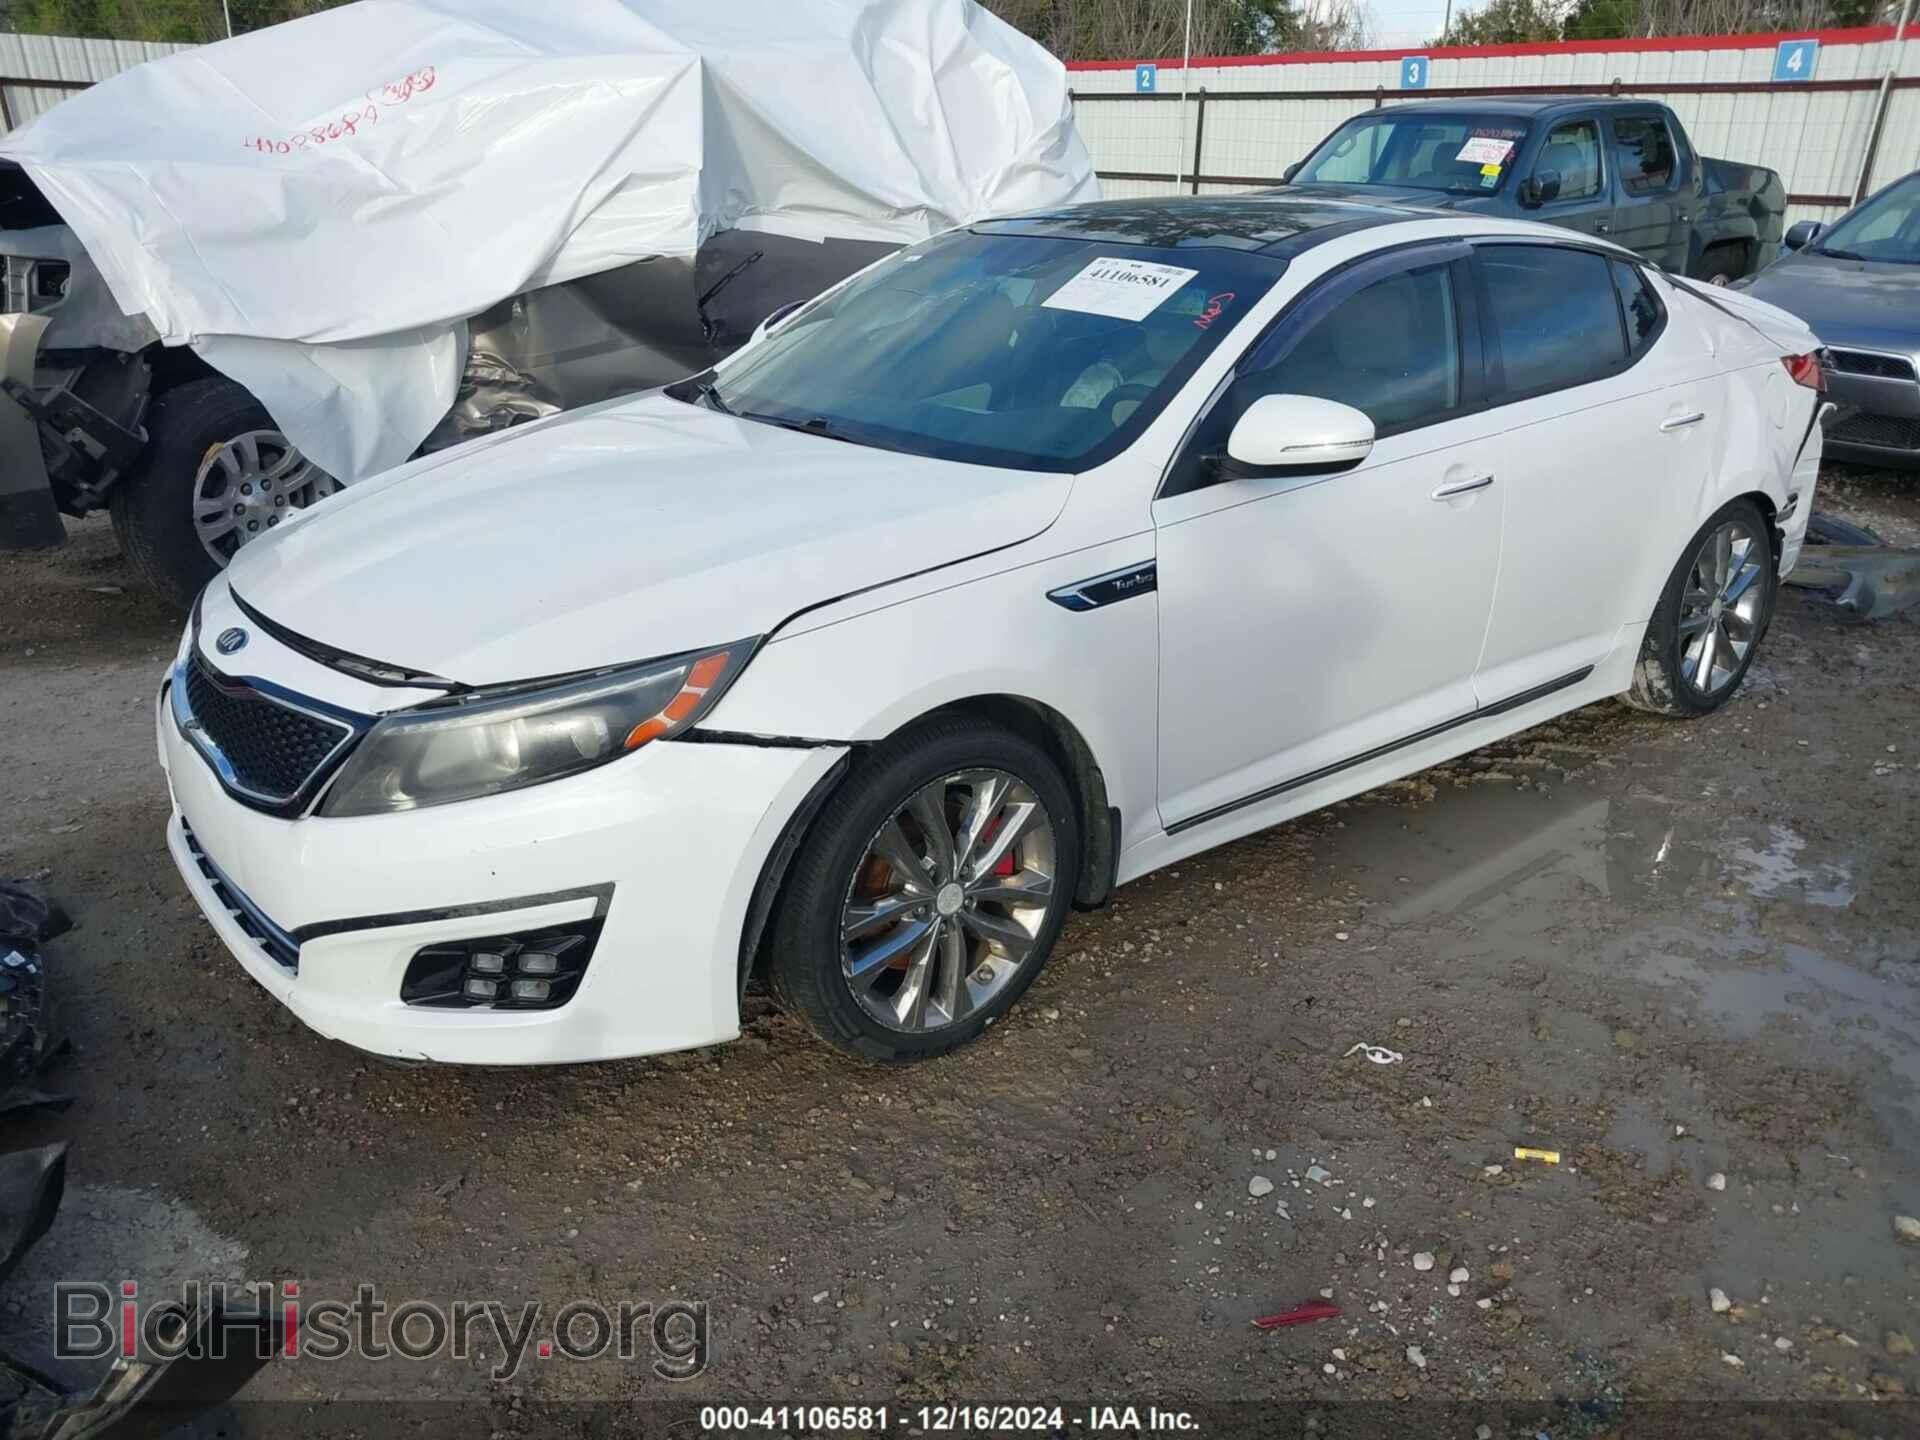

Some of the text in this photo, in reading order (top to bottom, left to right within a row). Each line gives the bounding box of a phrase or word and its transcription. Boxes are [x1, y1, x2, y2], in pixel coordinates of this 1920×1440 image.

[1787, 48, 1803, 72] 4
[1142, 70, 1151, 88] 2
[1408, 62, 1420, 84] 3
